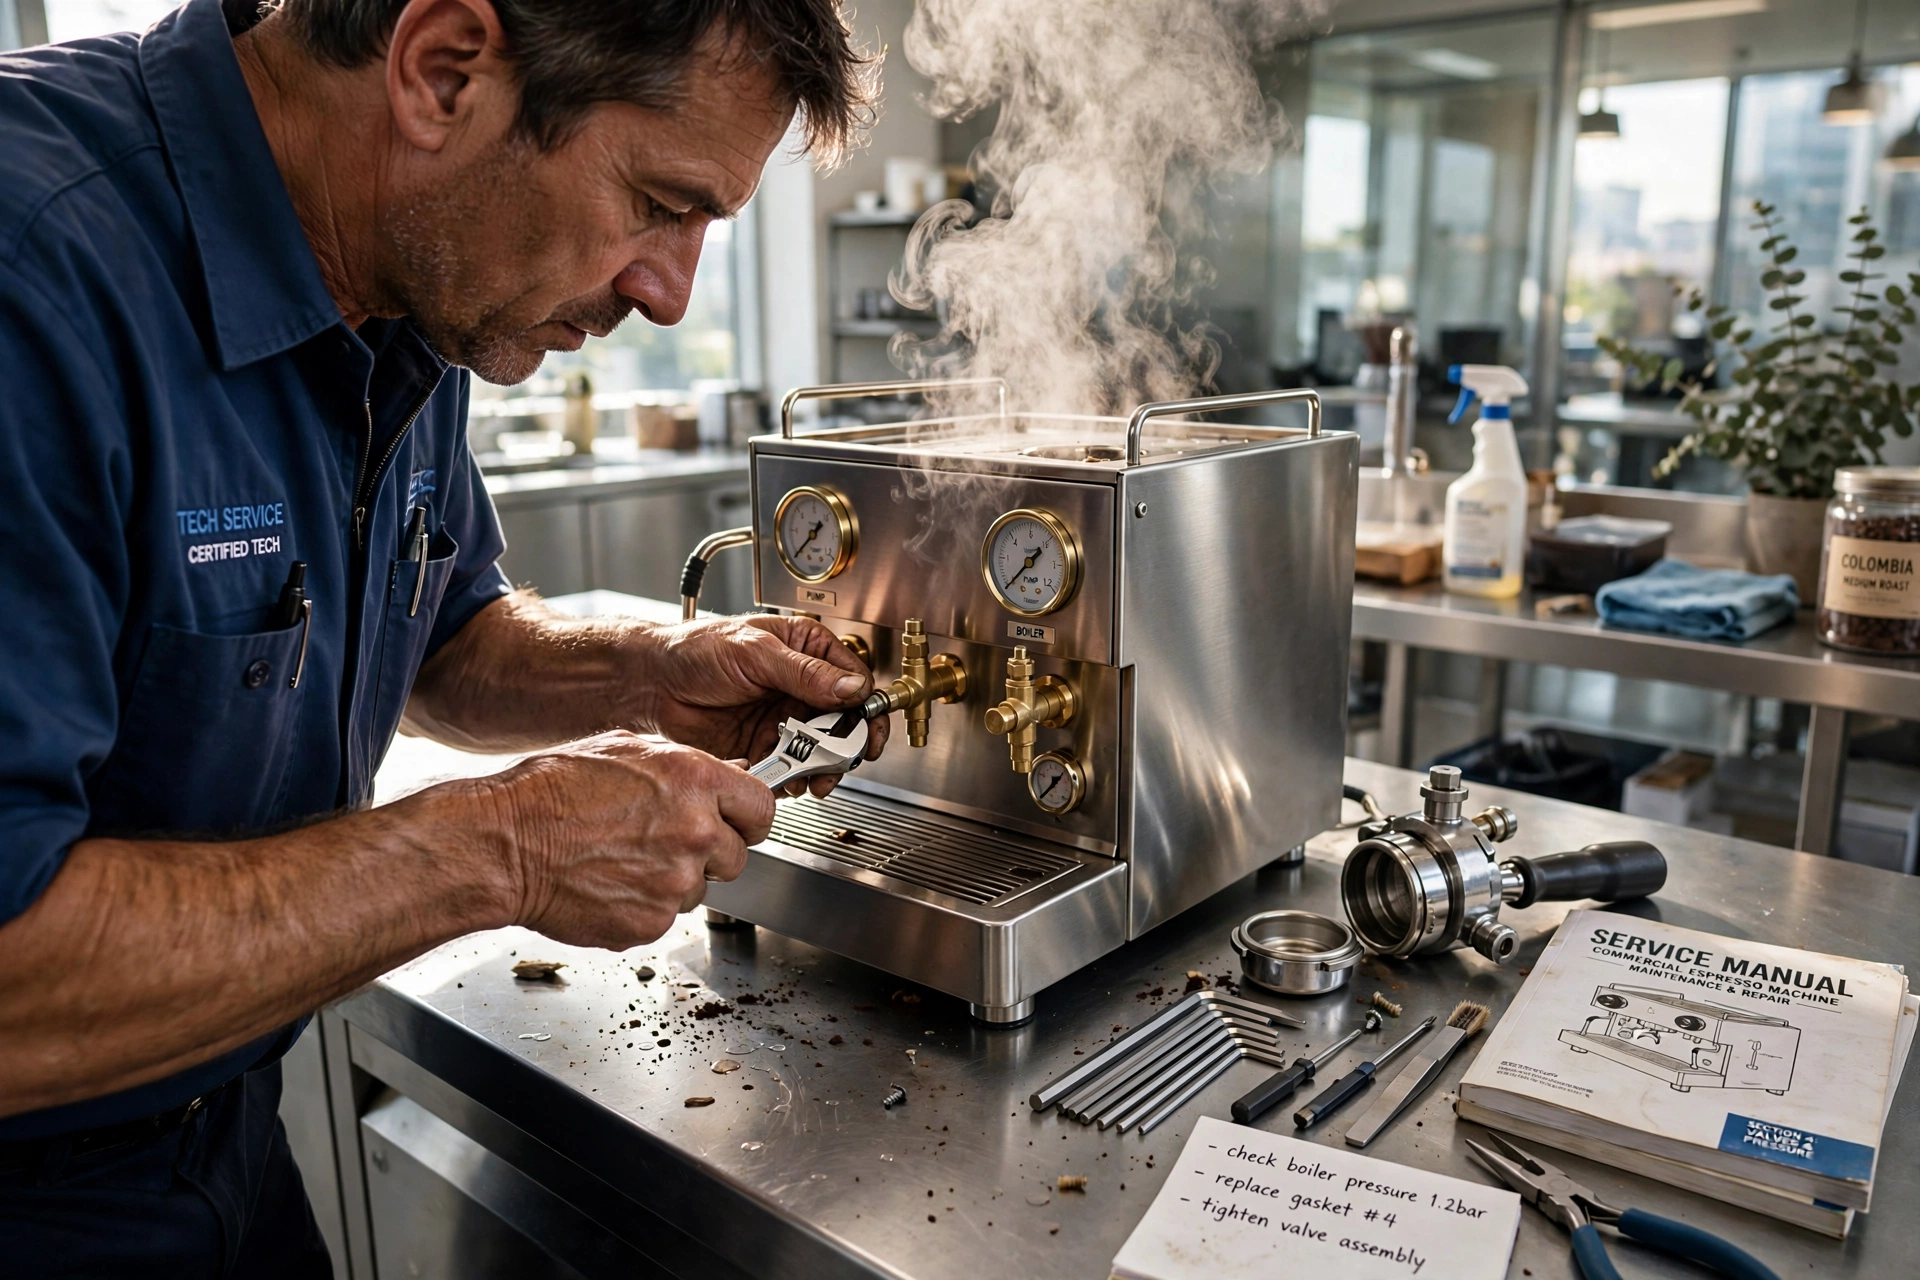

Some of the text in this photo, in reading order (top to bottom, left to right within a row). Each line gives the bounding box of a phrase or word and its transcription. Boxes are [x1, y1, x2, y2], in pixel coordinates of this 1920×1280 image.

[177, 503, 284, 535] TECH SERVICE
[188, 536, 281, 564] CERTIFIED TECH
[1841, 553, 1914, 575] COLOMBIA
[806, 591, 826, 601] PUMP
[1843, 576, 1909, 591] MEDIUM ROAST
[1016, 625, 1045, 640] BOILER
[1590, 928, 1854, 998] SERVICE MANUAL
[1592, 946, 1840, 1006] COMMERCIAL ESPRESSO MACHINE
[1628, 964, 1791, 1005] MAINTENANCE & REPAIR
[1215, 1174, 1280, 1199] replace
[1288, 1196, 1354, 1218] gasket
[1227, 1144, 1278, 1168] check
[1286, 1156, 1338, 1182] boiler
[1344, 1177, 1418, 1203] pressure
[1430, 1193, 1489, 1220] 1.2bar
[1202, 1197, 1269, 1228] tighten
[1281, 1221, 1328, 1243] valve
[1339, 1237, 1426, 1275] assembly
